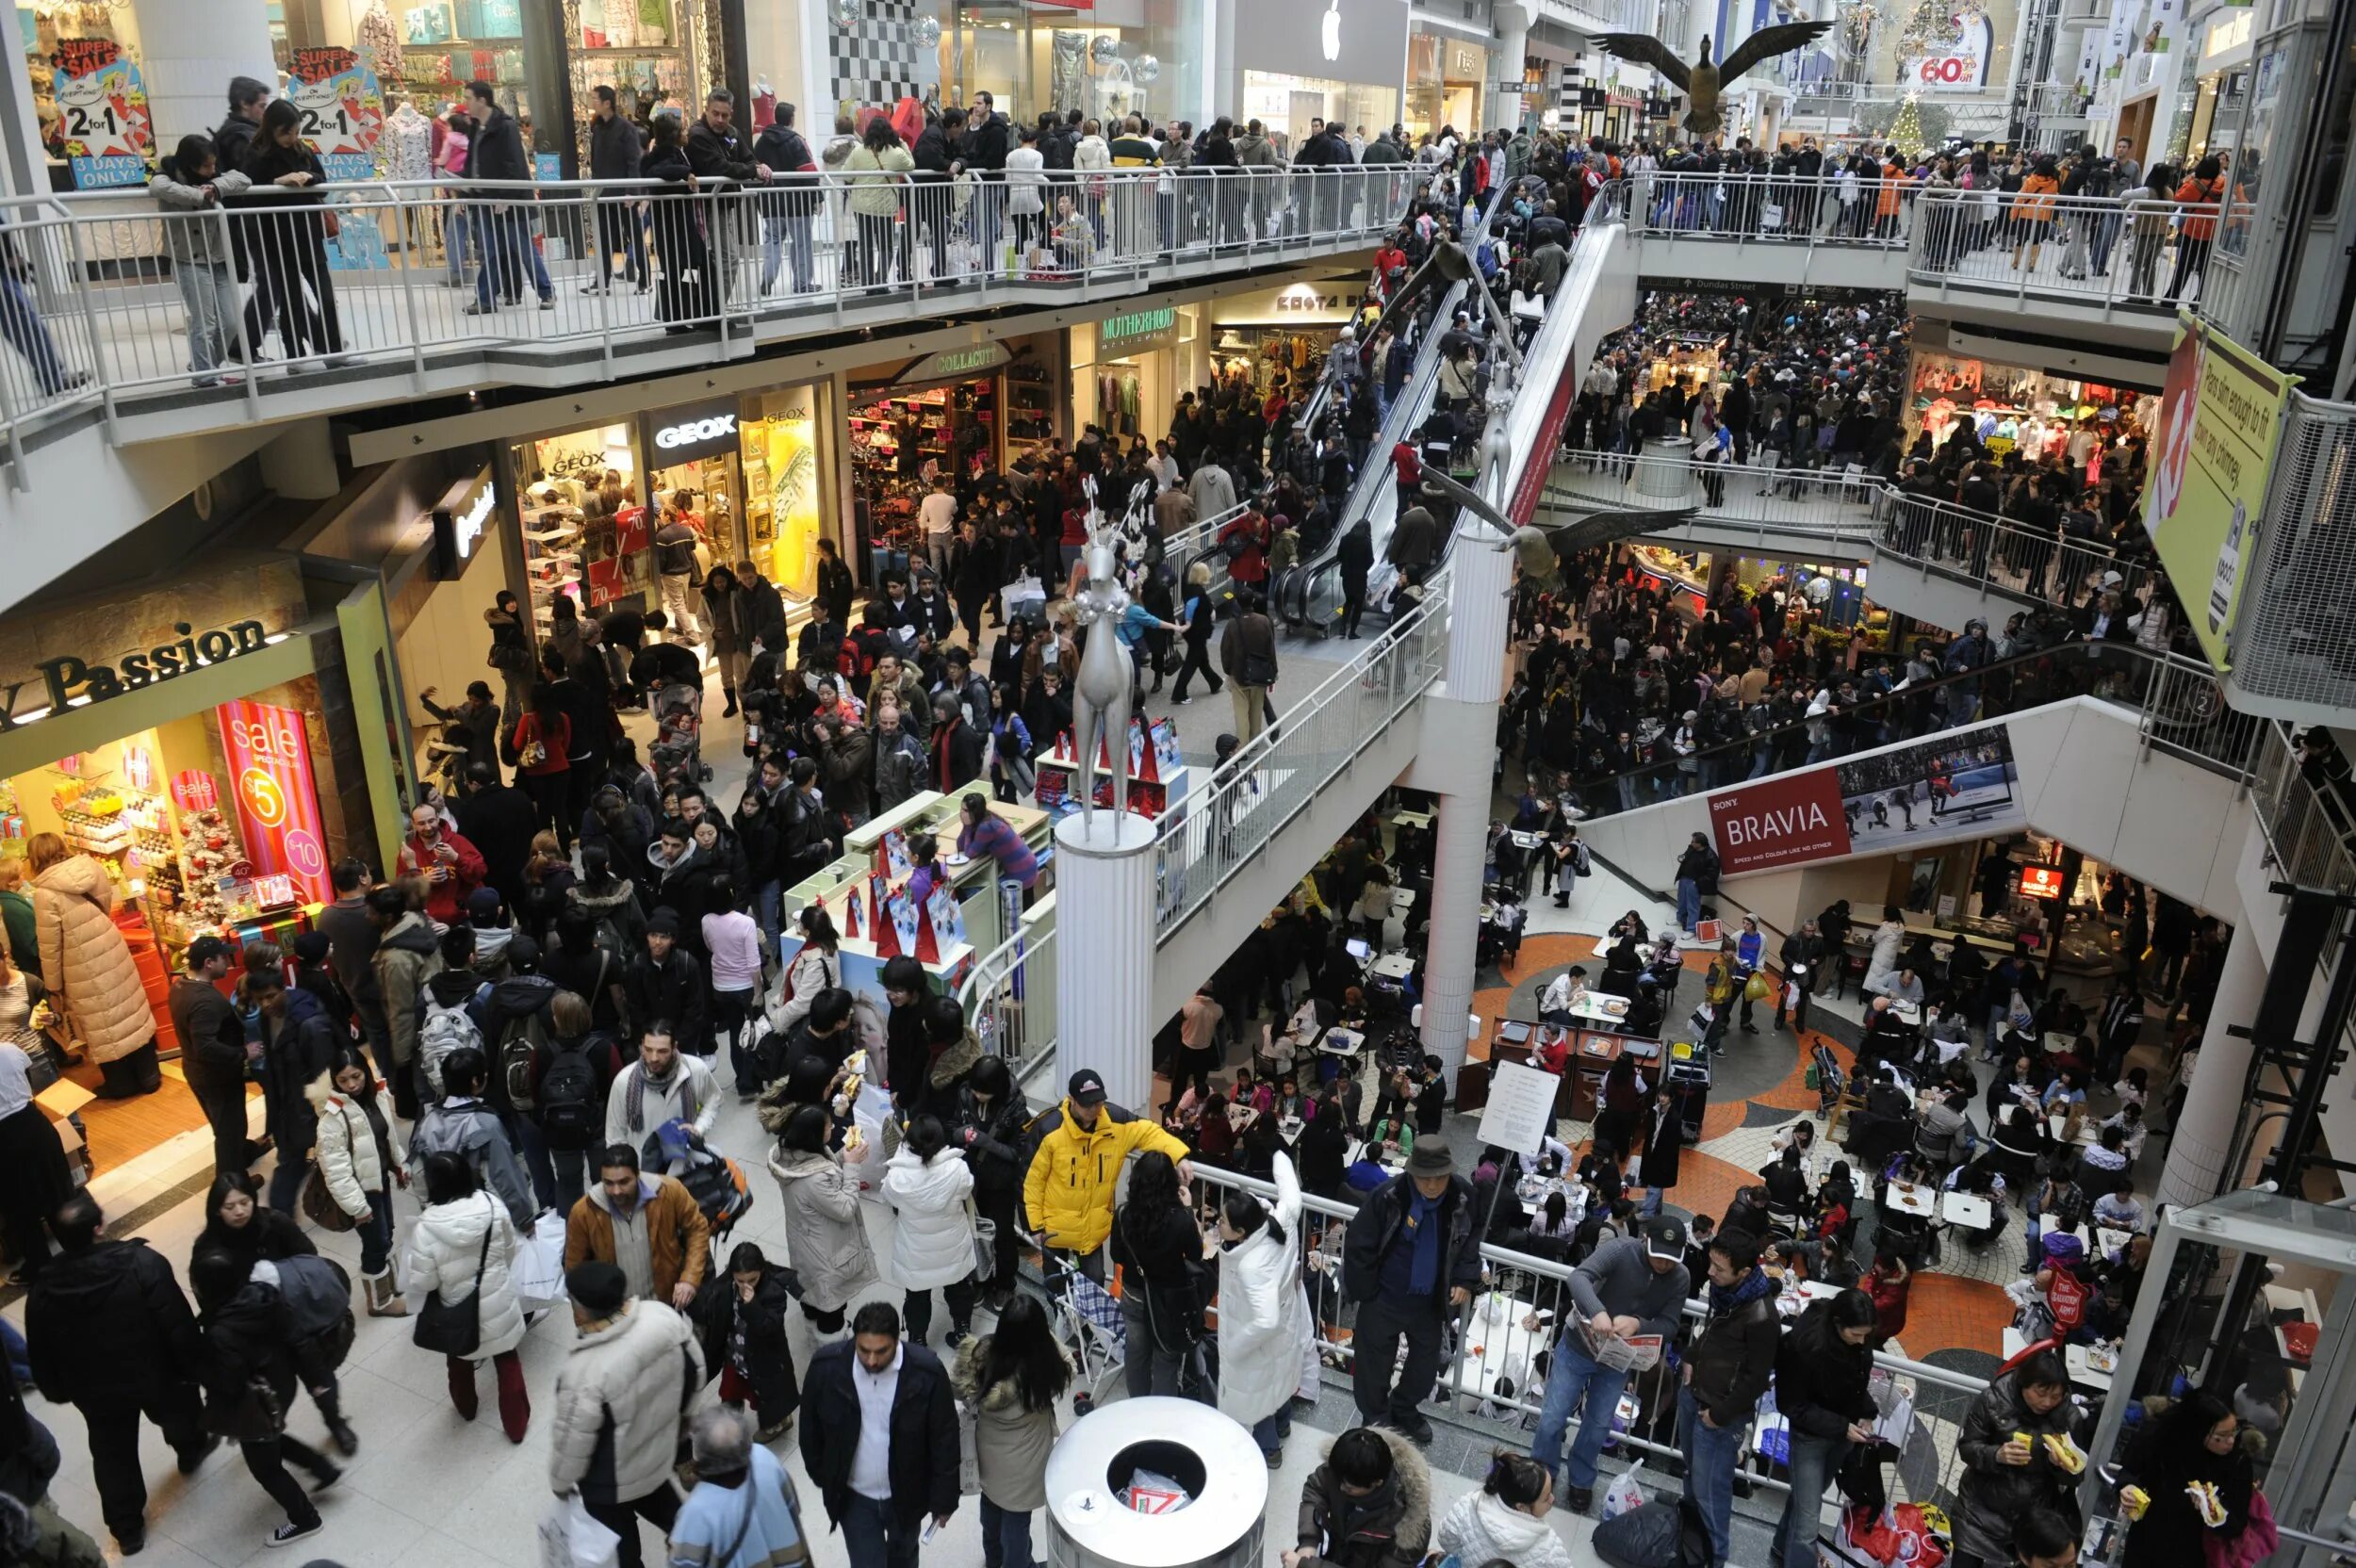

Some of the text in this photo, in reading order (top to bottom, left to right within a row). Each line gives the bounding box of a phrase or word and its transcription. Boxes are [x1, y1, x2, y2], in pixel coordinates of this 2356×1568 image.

[64, 41, 113, 58] SUPER
[300, 50, 351, 66] SUPER
[68, 53, 117, 80] SALE
[303, 60, 352, 85] SALE
[67, 106, 116, 136] 2 for 1
[301, 109, 348, 136] 2 for 1
[75, 157, 137, 172] 3 DAYS
[321, 155, 367, 167] DAYS
[83, 171, 136, 187] ONLY!
[326, 166, 365, 180] NLY!
[1696, 280, 1756, 291] Dundas Street
[1277, 296, 1338, 311] COSTA
[1103, 307, 1176, 340] MOTHERHOOD
[767, 407, 806, 424] GEOX
[2217, 375, 2230, 408] slim
[2228, 389, 2251, 432] enough
[2250, 400, 2260, 433] to
[2258, 406, 2269, 443] fit
[656, 415, 737, 449] GEOX
[2206, 433, 2218, 466] any
[553, 451, 606, 473] GEOX
[35, 620, 269, 718] Passion
[231, 717, 298, 758] sale
[177, 780, 212, 795] sale
[244, 776, 277, 818] $5
[1712, 798, 1738, 810] SONY
[1726, 802, 1828, 845] BRAVIA
[288, 839, 319, 868] $10
[2058, 1282, 2070, 1293] THE
[2059, 1305, 2076, 1316] ARMY
